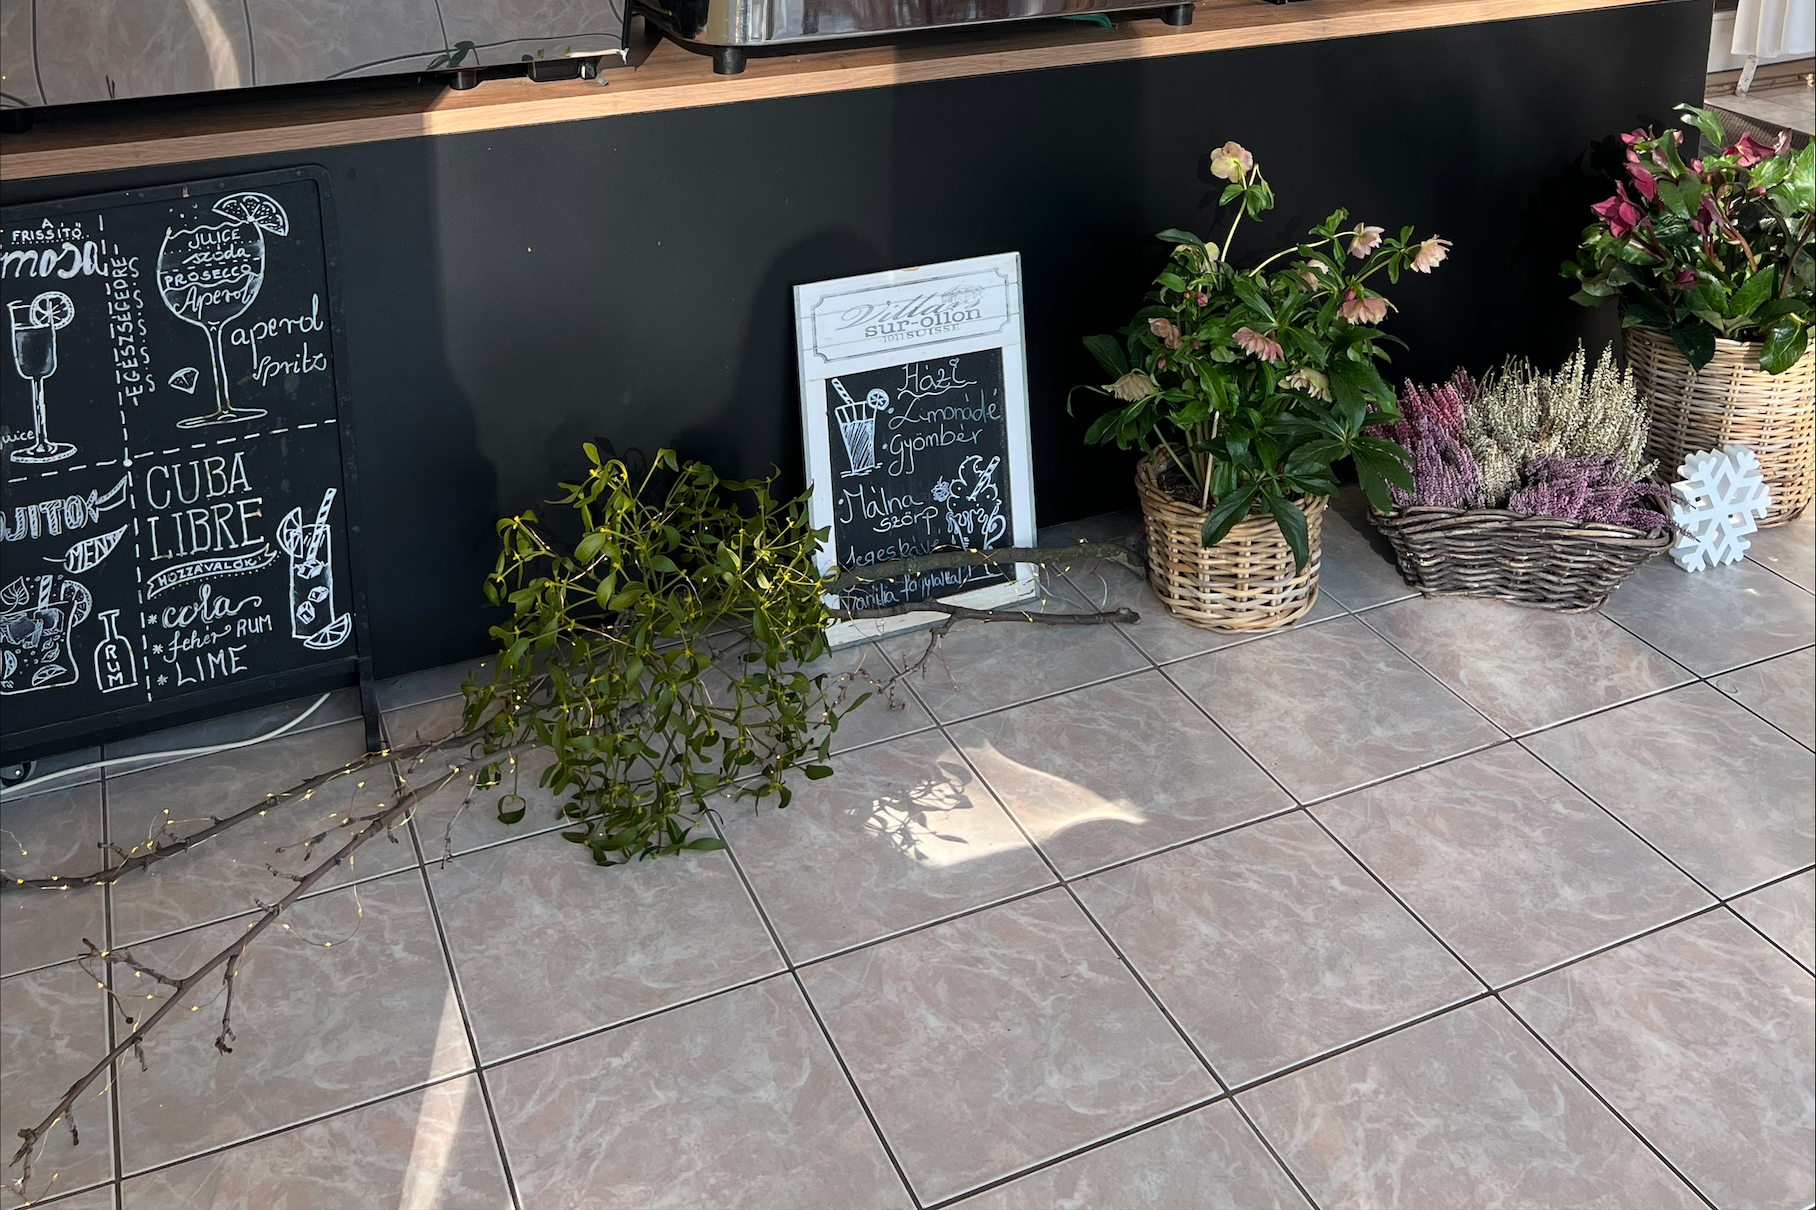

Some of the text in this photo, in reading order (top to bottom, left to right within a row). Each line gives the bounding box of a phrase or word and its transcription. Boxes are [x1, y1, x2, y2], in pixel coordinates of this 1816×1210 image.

[41, 217, 54, 229] A
[187, 228, 242, 250] JUICE
[0, 240, 109, 280] mosa
[164, 263, 252, 289] PROSECCO
[172, 274, 255, 320] Aperol
[834, 291, 985, 331] Villars
[230, 293, 324, 370] aperol
[864, 307, 983, 339] sur-ollon
[906, 323, 962, 340] SUISSE
[896, 357, 970, 393] Házi
[0, 429, 36, 445] uice
[887, 422, 983, 477] Gyömbér
[146, 451, 252, 510] CUBA
[838, 483, 925, 524] Málna
[872, 505, 939, 536] szörp
[147, 496, 265, 561] LIBRE
[161, 583, 263, 629] cola
[236, 614, 273, 638] RUM
[104, 644, 124, 687] RUM
[175, 644, 248, 687] LIME
